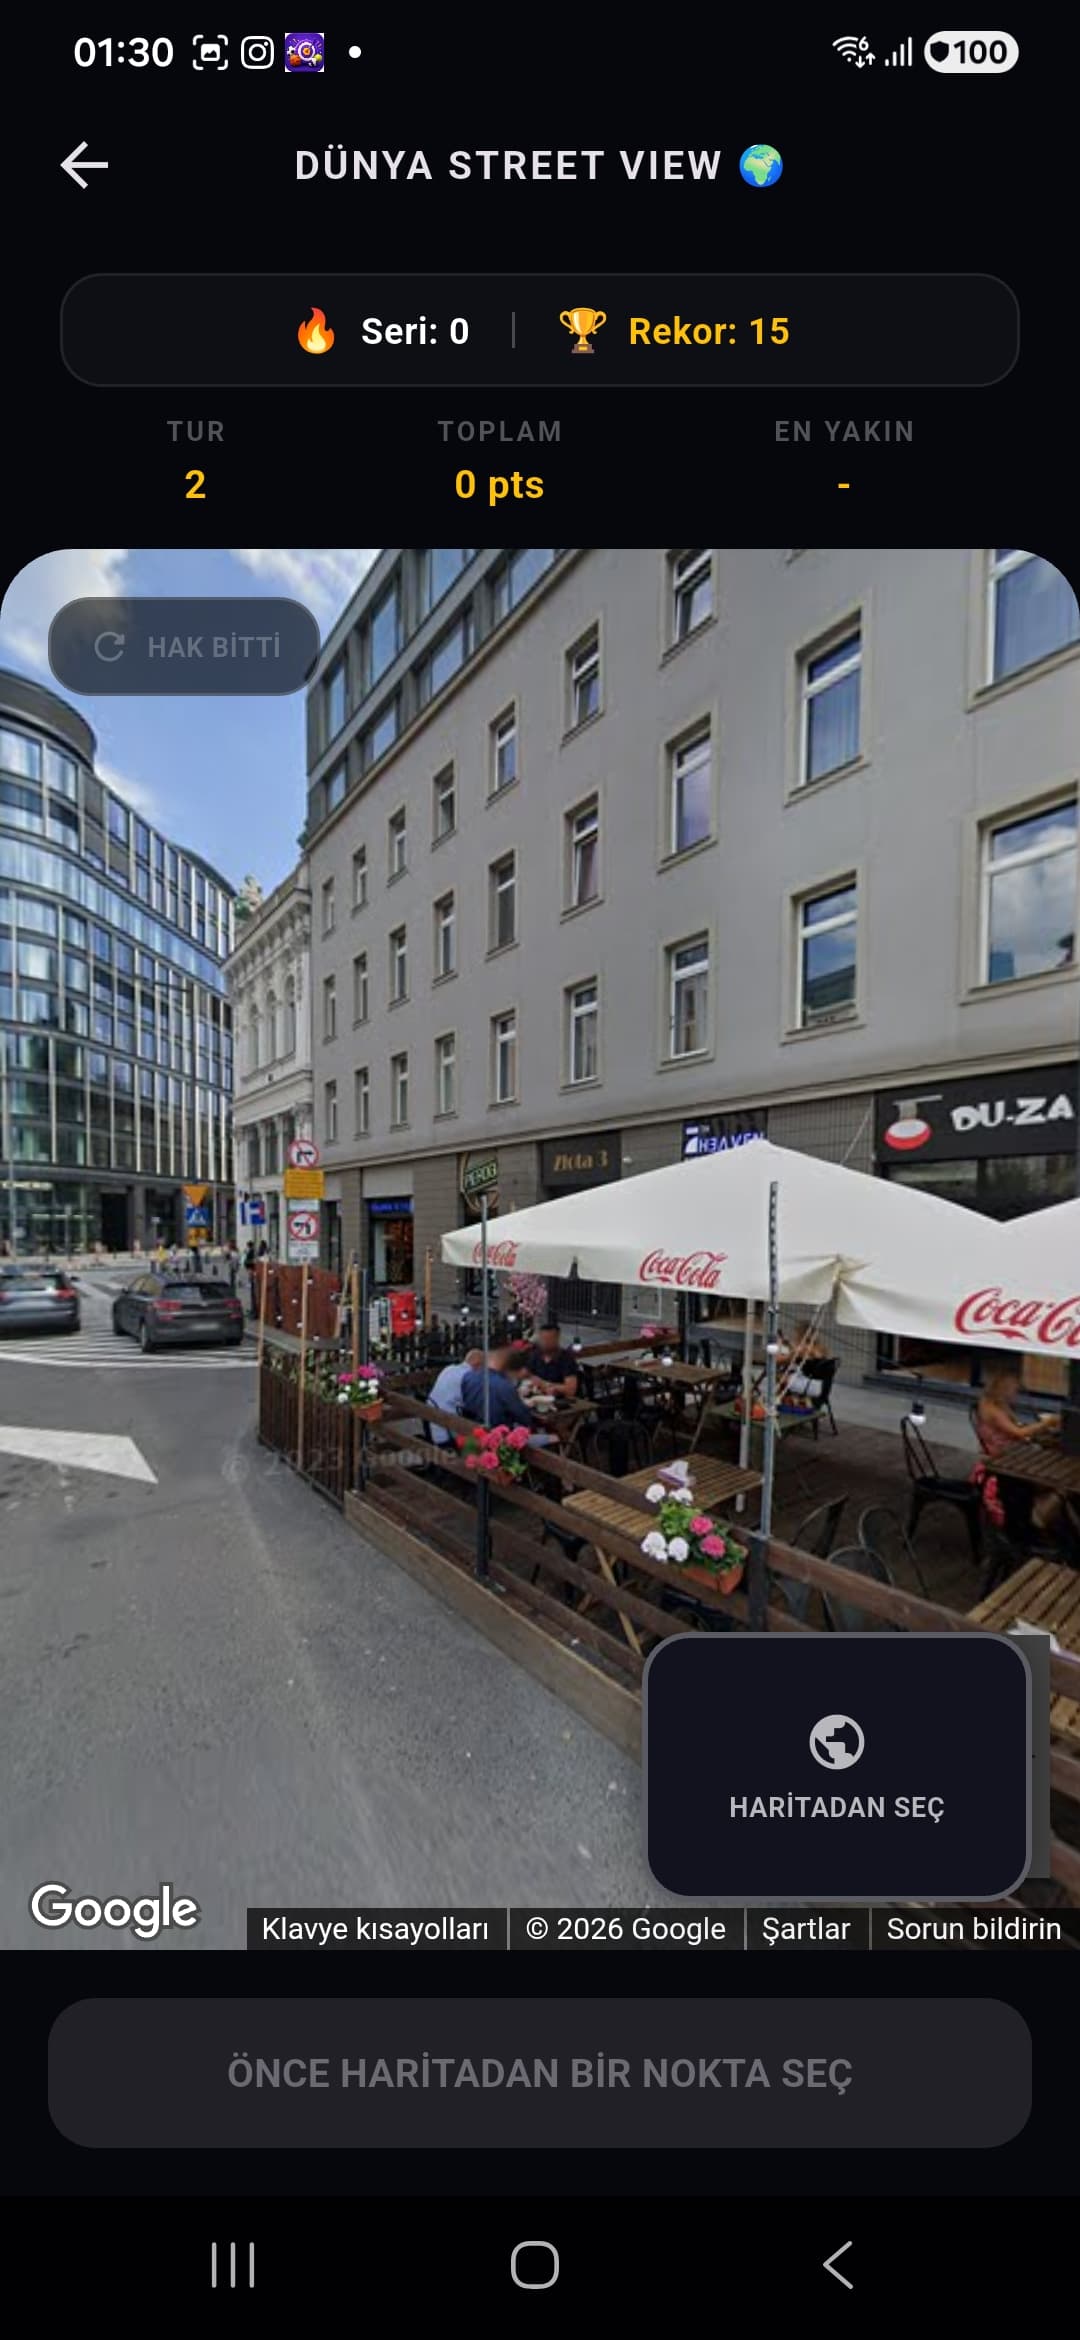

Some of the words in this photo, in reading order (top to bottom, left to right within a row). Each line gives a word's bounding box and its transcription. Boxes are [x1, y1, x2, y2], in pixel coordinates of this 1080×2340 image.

[75, 37, 173, 67] 01:30
[953, 40, 1008, 65] 100
[297, 144, 432, 180] DÜNYA
[449, 150, 604, 180] STREET
[619, 150, 721, 180] VIEW
[362, 316, 437, 345] Seri:
[450, 317, 469, 345] 0
[630, 316, 736, 345] Rekor:
[750, 317, 789, 345] 15
[167, 420, 225, 442] TUR
[438, 420, 561, 442] TOPLAM
[776, 420, 811, 442] EN
[824, 420, 913, 442] YAKIN
[185, 469, 206, 499] 2
[455, 469, 476, 499] 0
[490, 471, 544, 507] pts
[148, 636, 204, 659] HAK
[212, 631, 280, 659] BİTTİ
[730, 1791, 885, 1819] HARİTADAN
[894, 1796, 945, 1824] SEÇ
[228, 2051, 330, 2088] ÖNCE
[341, 2051, 558, 2088] HARİTADAN
[571, 2051, 631, 2088] BİR
[643, 2058, 771, 2088] NOKTA
[781, 2058, 853, 2096] SEÇ
